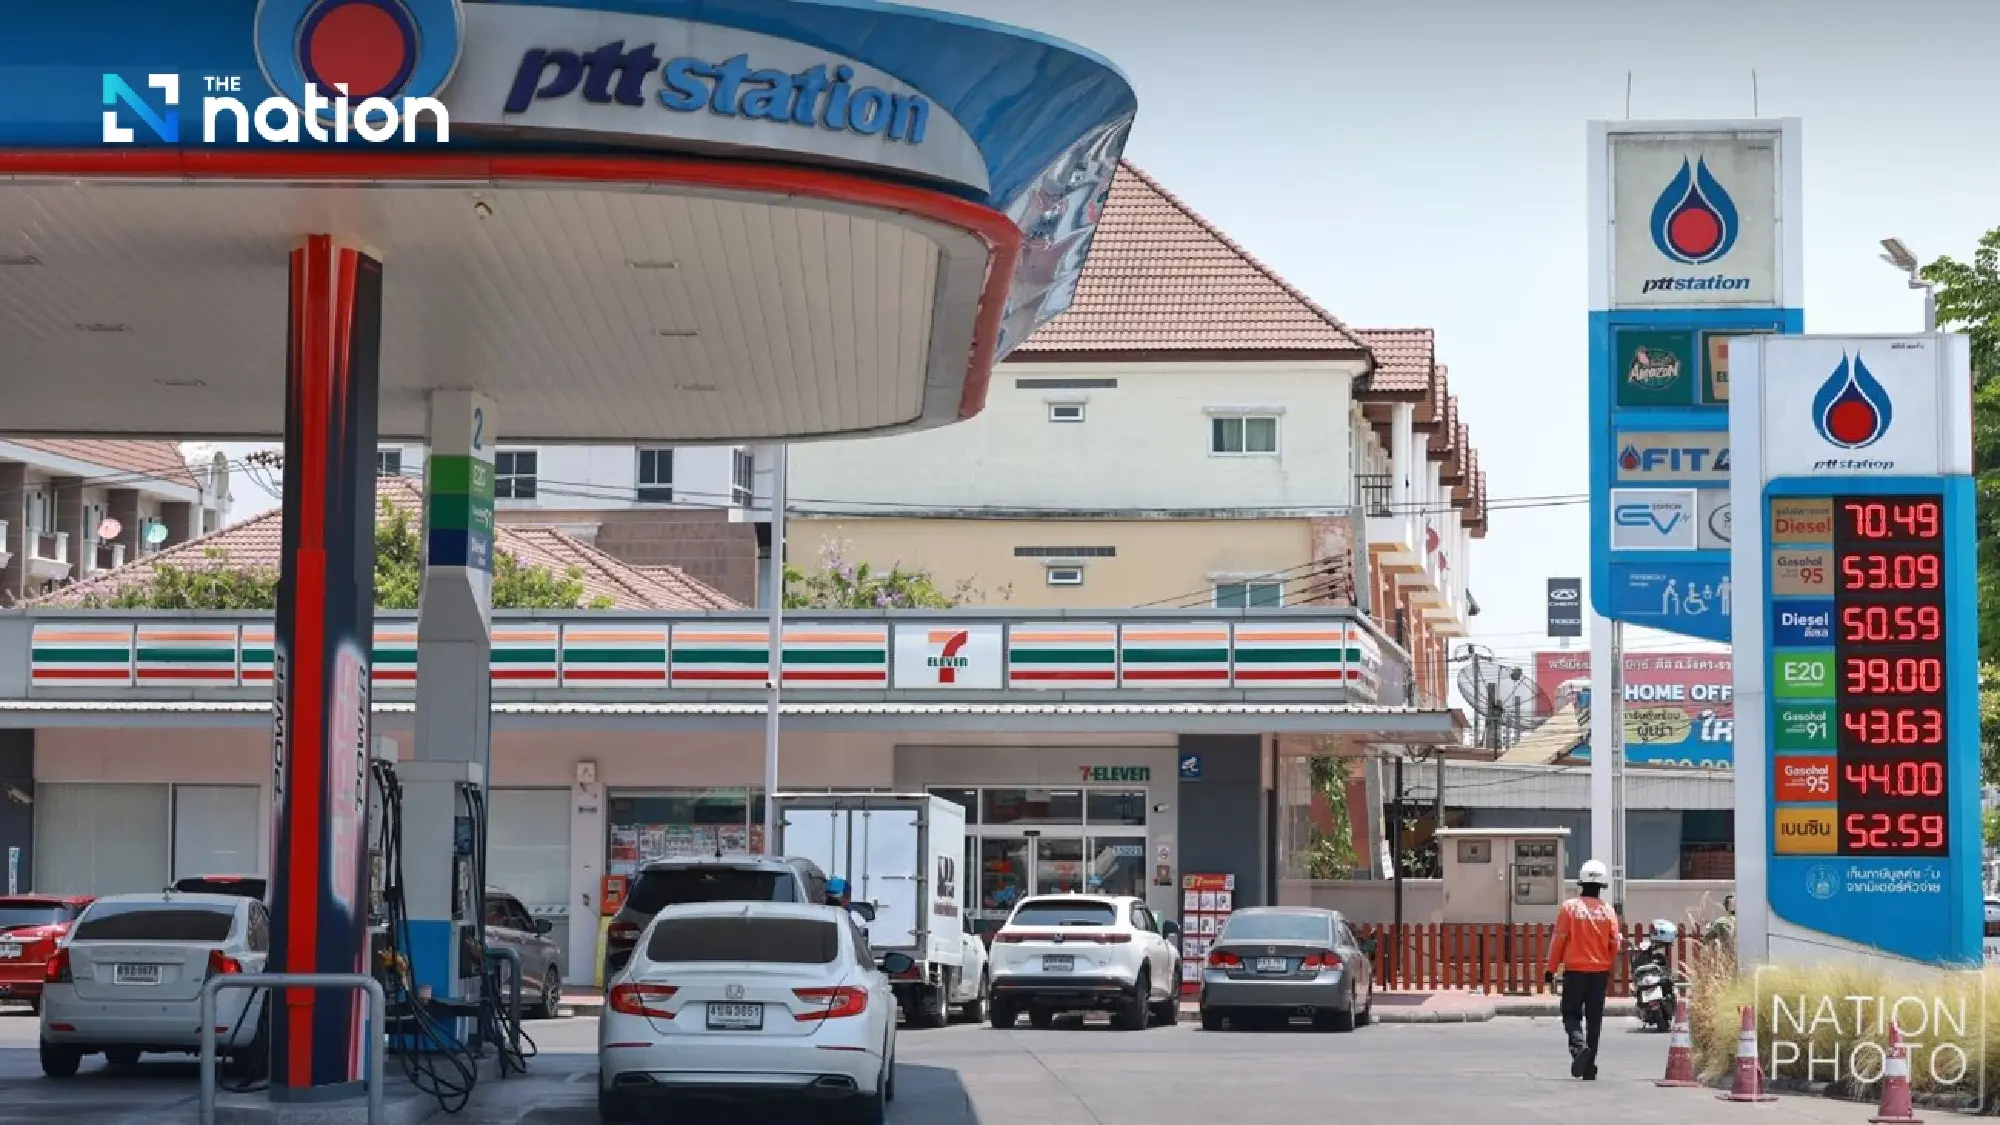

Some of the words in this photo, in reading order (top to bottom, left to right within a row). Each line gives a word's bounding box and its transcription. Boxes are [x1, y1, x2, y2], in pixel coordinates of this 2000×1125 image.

[473, 408, 483, 451] 2
[1642, 448, 1710, 472] FIT
[1776, 518, 1832, 534] Diesel
[1845, 503, 1938, 537] 70.49
[1777, 556, 1822, 566] Gasohol
[1800, 567, 1824, 584] 95
[1843, 555, 1939, 589] 53.09
[1782, 612, 1829, 626] Diesel
[1843, 606, 1940, 640] 50.59
[1784, 662, 1825, 681] E20
[1847, 659, 1941, 692] 39.00
[1625, 684, 1685, 700] HOME
[1783, 711, 1826, 721] Gasohol
[1807, 722, 1827, 740] 91
[1845, 710, 1942, 744] 43.63
[1785, 765, 1829, 775] Gasohol
[1846, 762, 1943, 796] 44.00
[1806, 776, 1830, 793] 95
[1781, 819, 1832, 837] เบนซิน
[1846, 813, 1943, 848] 52.59
